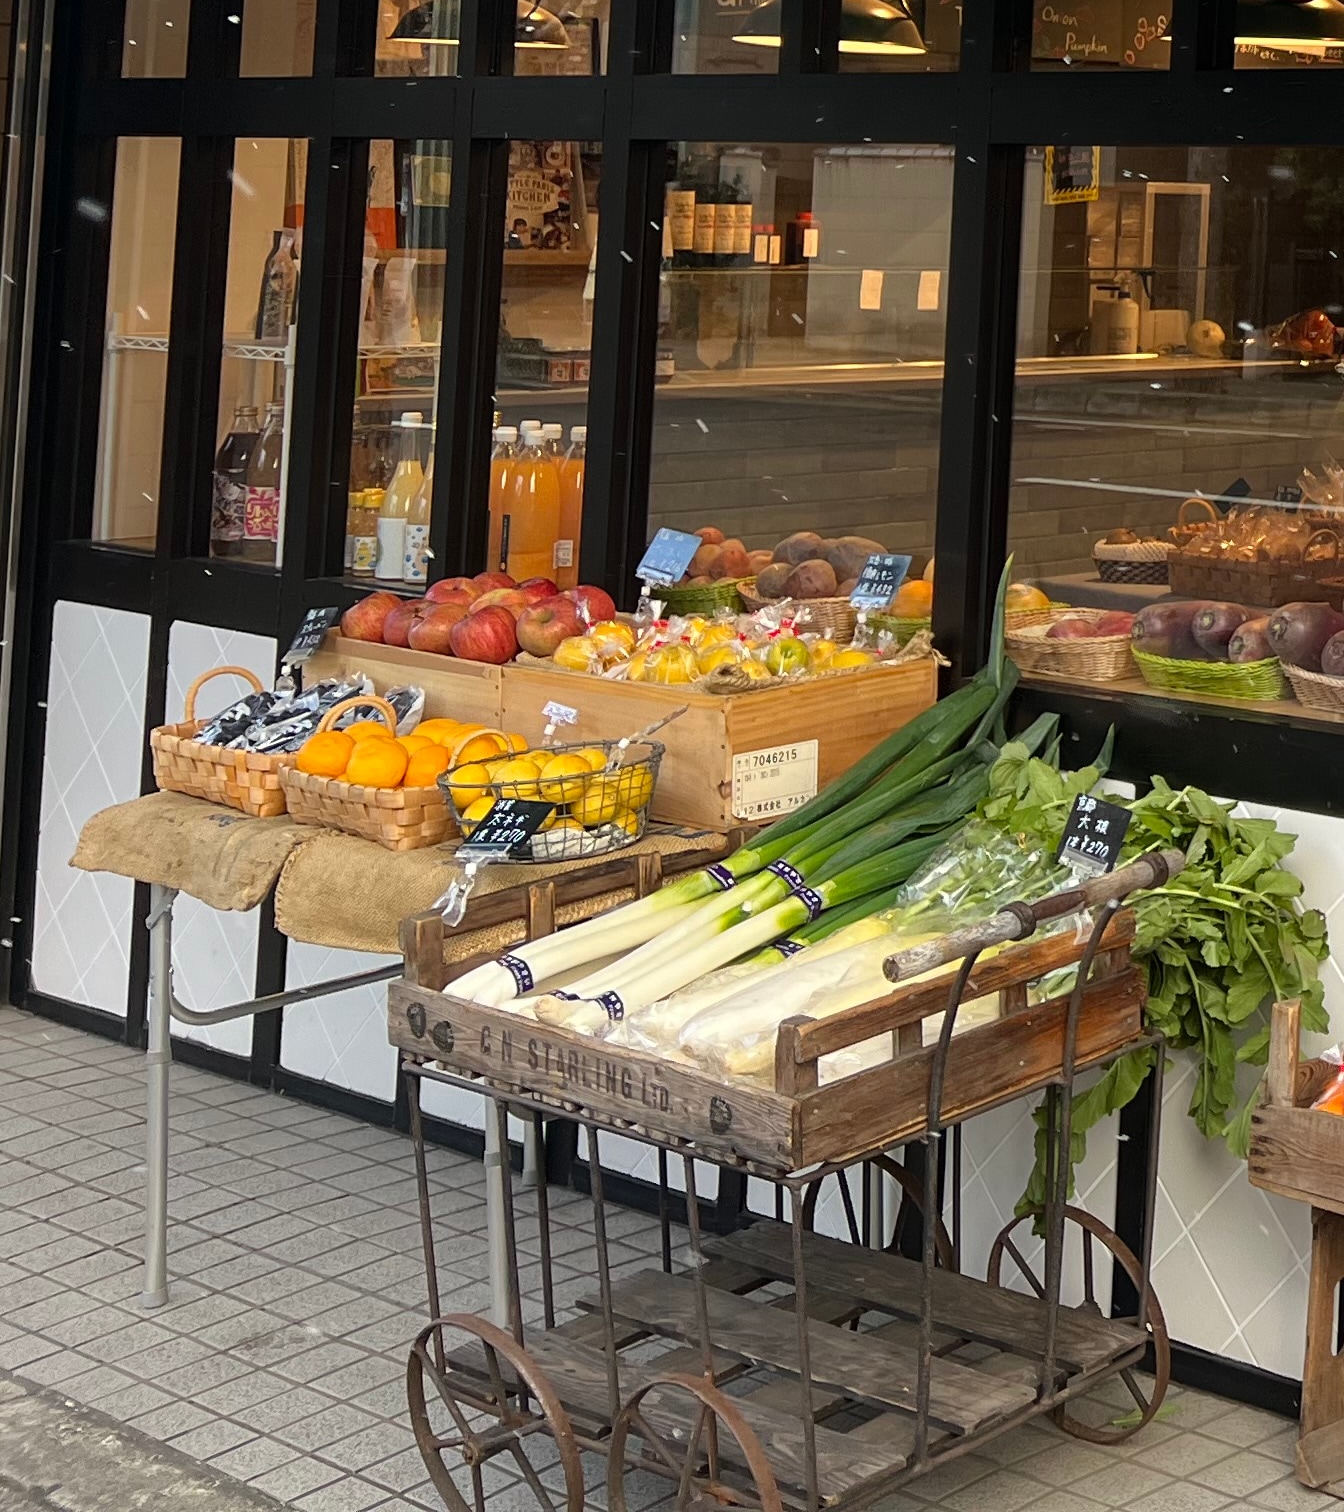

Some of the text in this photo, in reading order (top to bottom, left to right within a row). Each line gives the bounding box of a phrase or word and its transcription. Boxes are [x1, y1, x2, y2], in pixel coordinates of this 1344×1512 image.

[752, 748, 798, 767] 7046215
[489, 828, 527, 844] ¥270
[527, 1037, 634, 1096] STARLING
